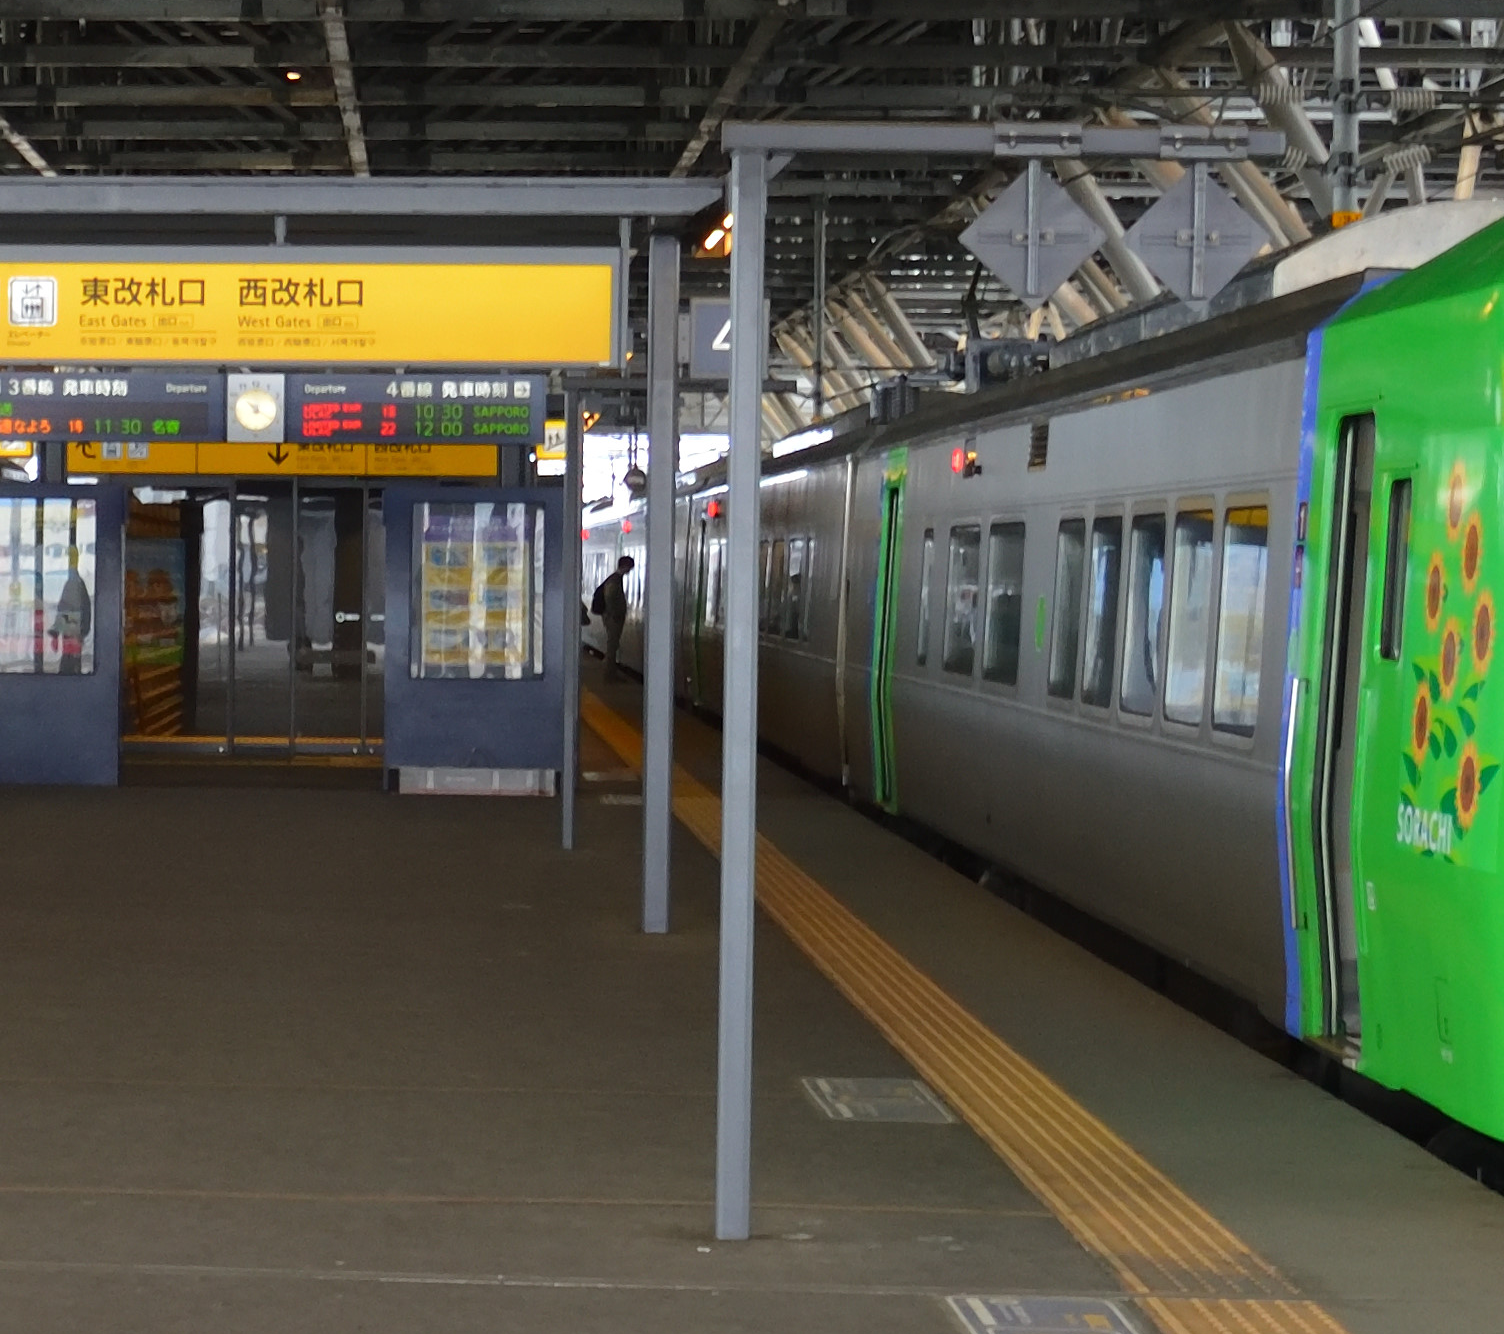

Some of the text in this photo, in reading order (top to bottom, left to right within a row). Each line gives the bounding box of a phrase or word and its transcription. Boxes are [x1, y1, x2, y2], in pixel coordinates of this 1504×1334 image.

[80, 277, 365, 308] 東改札口 西改札口
[79, 315, 147, 328] East Gates
[238, 315, 311, 328] West Gates
[473, 405, 529, 418] SAPPORO
[473, 422, 529, 436] SAPPORO
[1397, 803, 1452, 855] SORACHI
